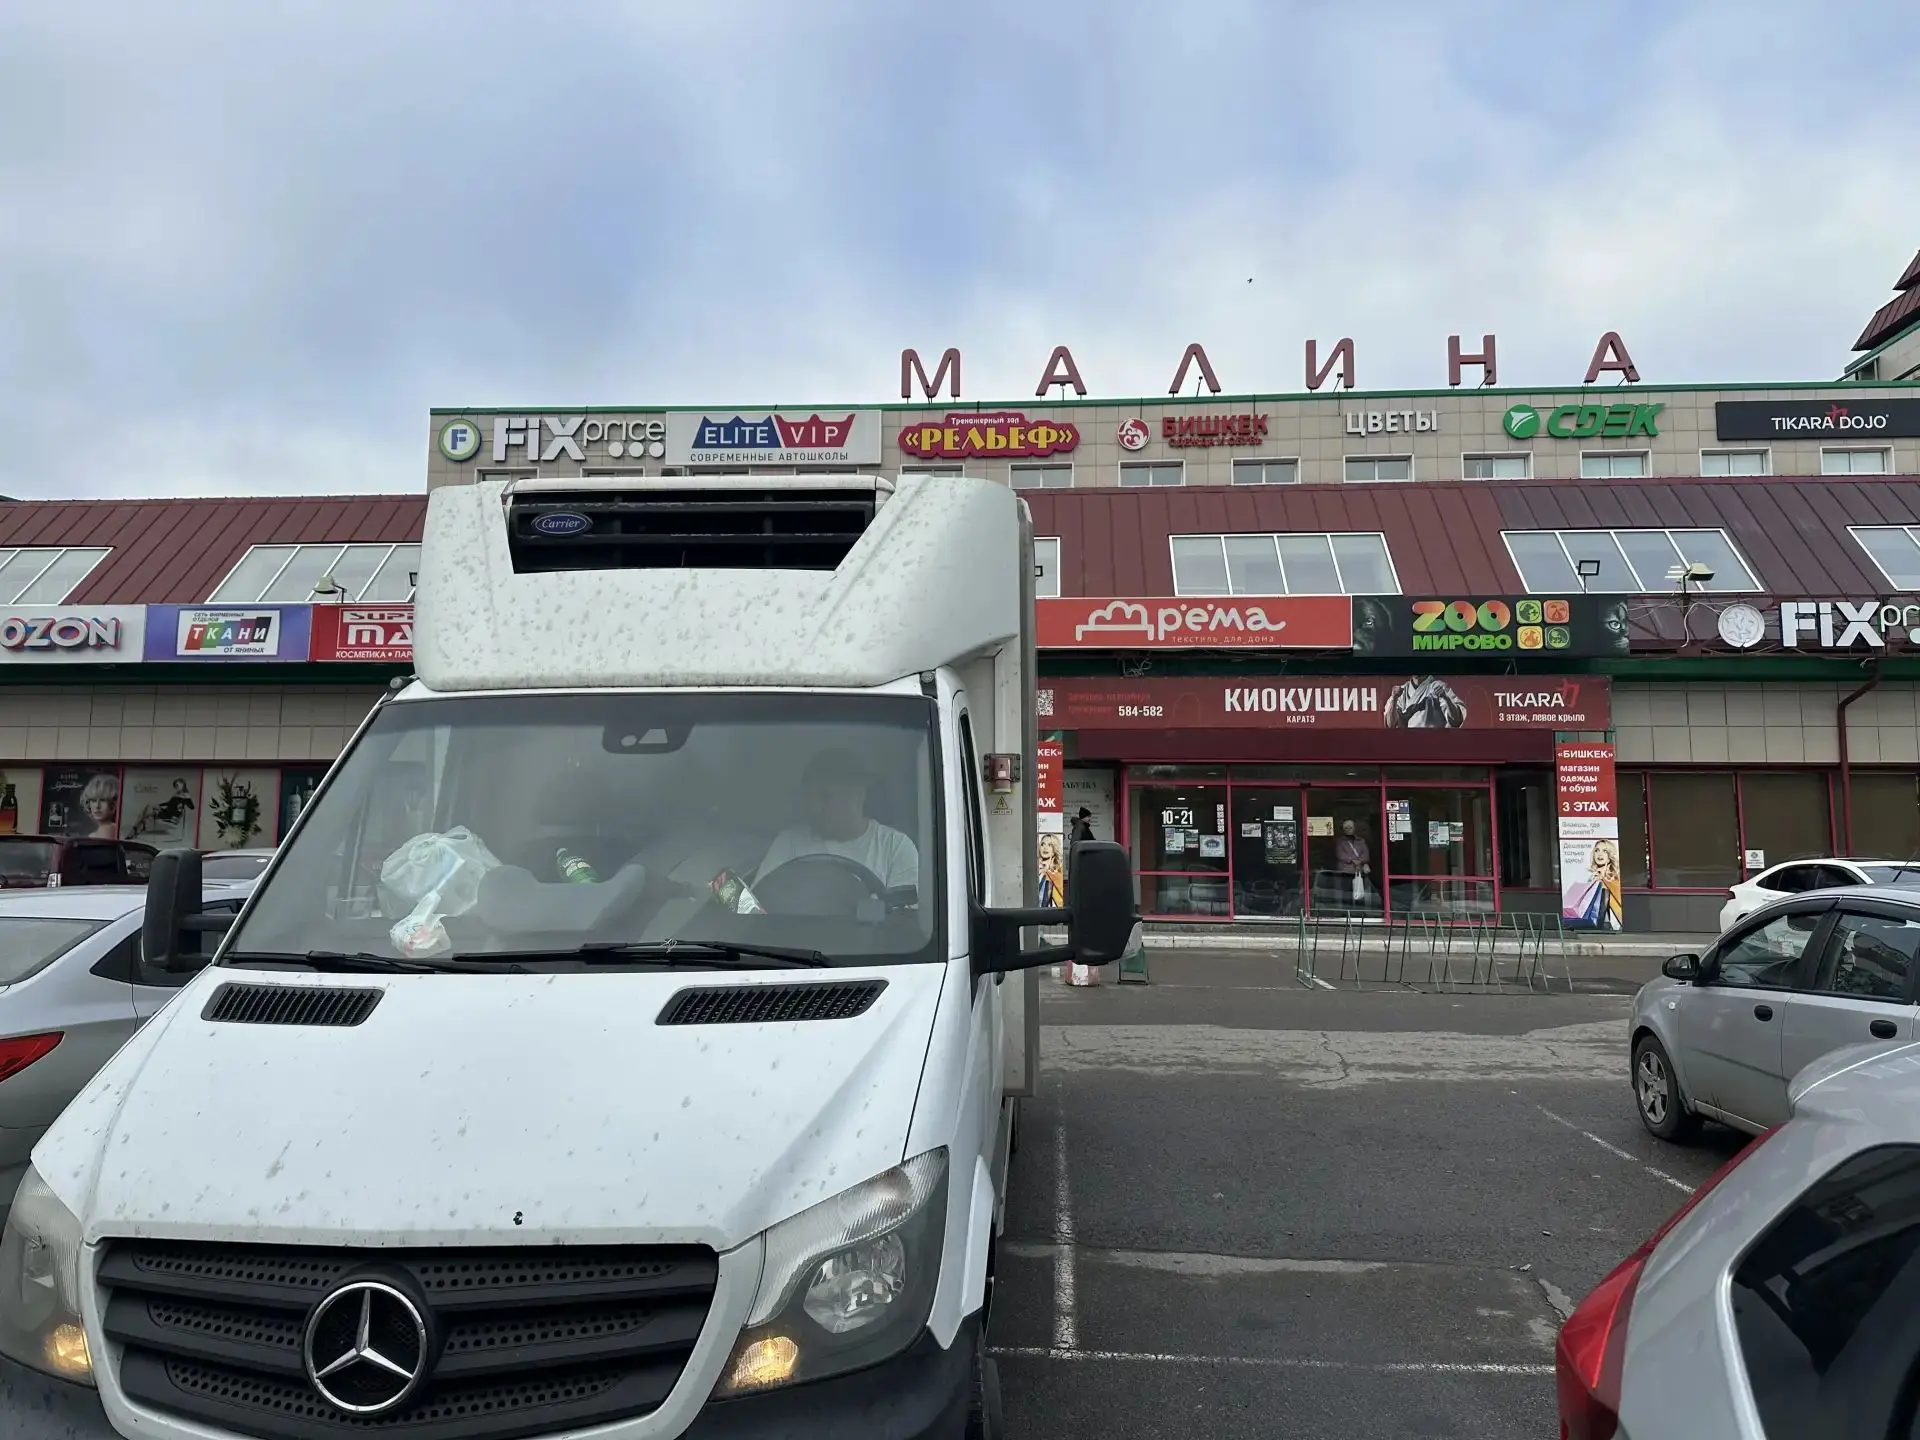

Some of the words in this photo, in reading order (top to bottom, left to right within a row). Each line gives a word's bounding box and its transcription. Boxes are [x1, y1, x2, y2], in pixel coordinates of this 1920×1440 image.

[901, 332, 1640, 398] МАЛИНА
[1162, 414, 1268, 437] БИШКЕК
[1346, 410, 1437, 436] ЦВЕТЫ
[1771, 416, 1834, 430] TIKARA
[1839, 415, 1887, 429] DOJO
[583, 419, 665, 447] price
[704, 427, 769, 444] ELITE
[790, 426, 839, 444] VIP
[690, 453, 773, 462] СОВРЕМЕННЫЕ
[779, 452, 848, 461] АВТОШКОЛЫ
[542, 519, 580, 528] Carrier
[1412, 600, 1511, 632] ZOO
[0, 617, 120, 649] OZON
[193, 627, 266, 640] ТКАНИ
[1412, 634, 1512, 650] МИРОВО
[336, 650, 386, 658] КОСМЕТИКА
[1224, 687, 1377, 712] КИОКУШИН
[1494, 692, 1565, 707] TIKARA
[1118, 705, 1163, 717] 584-582
[1498, 713, 1505, 722] 3
[1532, 714, 1556, 722] левое
[1558, 714, 1585, 723] крыло
[1286, 715, 1315, 723] КАРАТЭ
[1560, 775, 1598, 783] одежды
[1569, 783, 1597, 793] обуви
[1562, 801, 1570, 812] 3
[1573, 801, 1609, 812] ЭТАЖ
